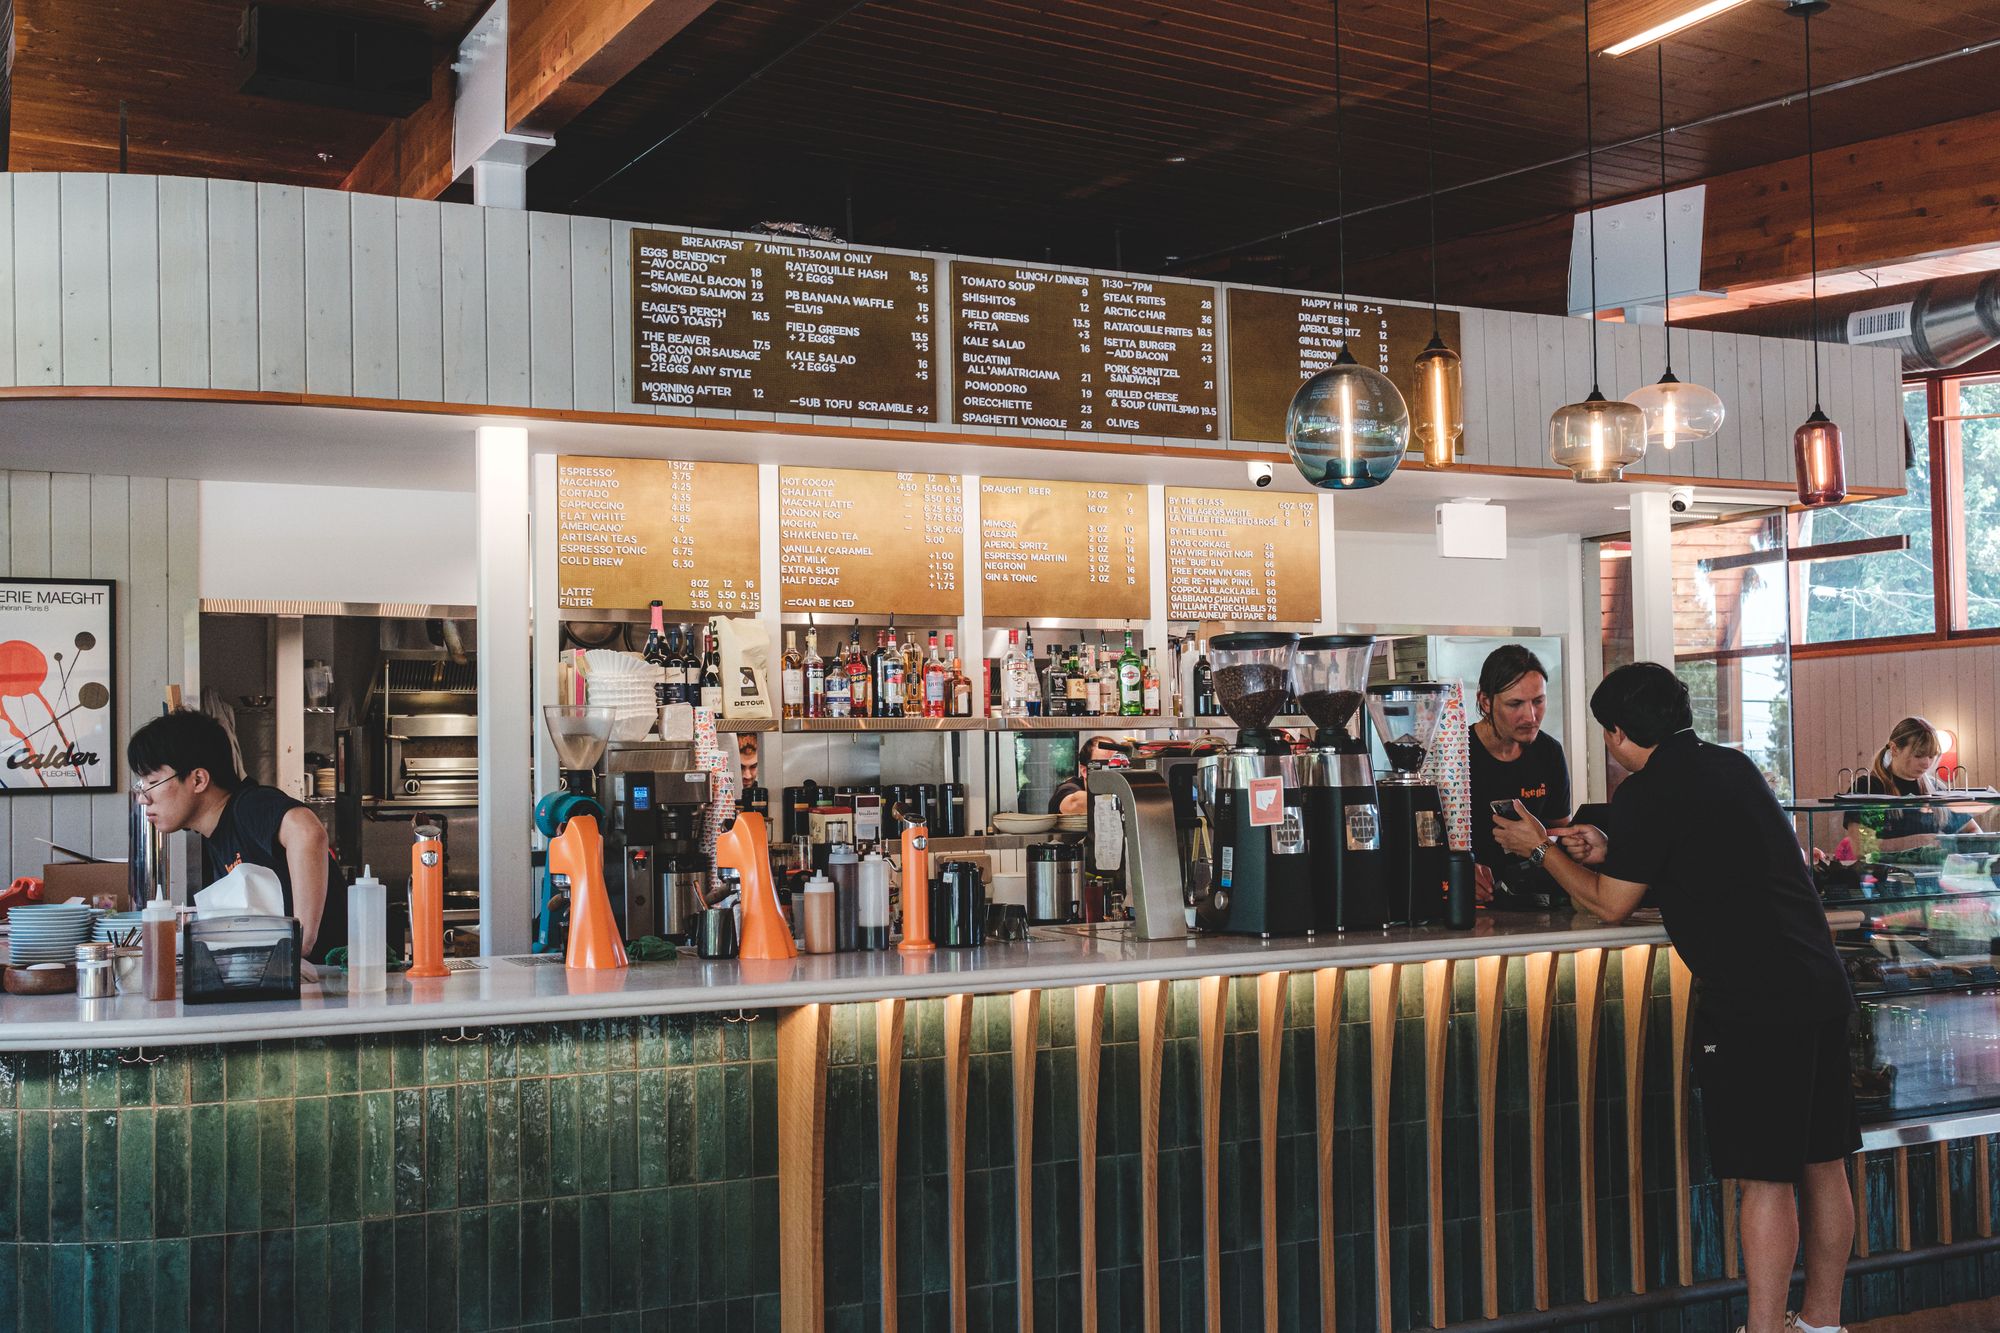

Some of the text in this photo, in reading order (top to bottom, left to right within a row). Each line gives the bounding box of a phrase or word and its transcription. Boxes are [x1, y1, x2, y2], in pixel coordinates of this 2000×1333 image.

[641, 247, 726, 264] EGGS BENEDICT
[682, 237, 872, 263] BREAKFAST 7 UNTIL 11:30AM ONLY
[786, 262, 928, 282] RATATOUILLE HASH 18.5
[1016, 270, 1047, 282] LUNCH
[1056, 275, 1088, 286] DINNER
[961, 276, 1006, 288] TOMATO
[1008, 281, 1035, 291] SOUP
[786, 290, 929, 312] PB BANANA WAFFLE 15
[963, 293, 1089, 312] SHISHITOS 12
[1103, 293, 1211, 309] STEAK FRITES 28
[1302, 298, 1331, 308] HAPPY
[1334, 302, 1357, 312] HOUR
[690, 306, 726, 317] PERCH
[752, 311, 770, 321] 16.5
[1299, 313, 1327, 323] DRAFT
[1328, 316, 1349, 325] BEER
[786, 322, 928, 342] FIELD GREENS 13.5
[1104, 322, 1212, 337] RATATOUILLE FRITES 18.5
[642, 331, 770, 350] THE BEAVER 17.5
[1104, 337, 1212, 351] ISETTA BURGER 22
[787, 351, 928, 368] KALE SALAD 16
[963, 353, 1010, 365] BUCATINI
[1301, 349, 1336, 360] NEGRONI
[1105, 364, 1180, 377] PORK SCHNITZEL
[1379, 365, 1388, 373] 10
[1082, 374, 1090, 382] 21
[1111, 374, 1212, 389] SANDWICH 21
[642, 382, 763, 398] MORNING AFTER 12
[965, 381, 1092, 398] POMODORO 19
[1105, 390, 1178, 402] GRILLED CHEESE
[652, 392, 693, 404] SANDO
[825, 399, 852, 409] TOFU
[858, 401, 913, 413] SCRAMBLE
[964, 397, 1092, 414] ORECCHIETTE 23
[963, 413, 1092, 429] SPAGHETTI VONGOLE 26
[1106, 418, 1211, 432] OLIVES 9
[560, 479, 619, 487] MACCHIATO
[982, 485, 1051, 495] DRAUGHT BEER
[560, 501, 624, 510] CAPPUCCINO
[561, 512, 586, 521] FLAT
[983, 520, 1017, 528] MIMOSA
[562, 534, 608, 542] ARTISAN
[611, 535, 637, 543] TEAS
[841, 532, 858, 540] TEA
[559, 545, 613, 553] ESPRESSO
[615, 546, 647, 554] TONIC
[985, 541, 1048, 550] APEROL SPRITZ
[559, 556, 589, 565] COLD
[593, 558, 623, 566] BREW
[781, 554, 802, 562] OAT
[985, 552, 1028, 560] ESPRESSO
[985, 562, 1025, 570] NEGRONI
[781, 576, 840, 585] HALF DECAF
[1011, 574, 1037, 582] TONIC
[1127, 576, 1135, 584] 15
[38, 592, 104, 605] MAEGHT
[1171, 611, 1228, 619] CHATEAUNEUF
[7, 742, 100, 769] Calder
